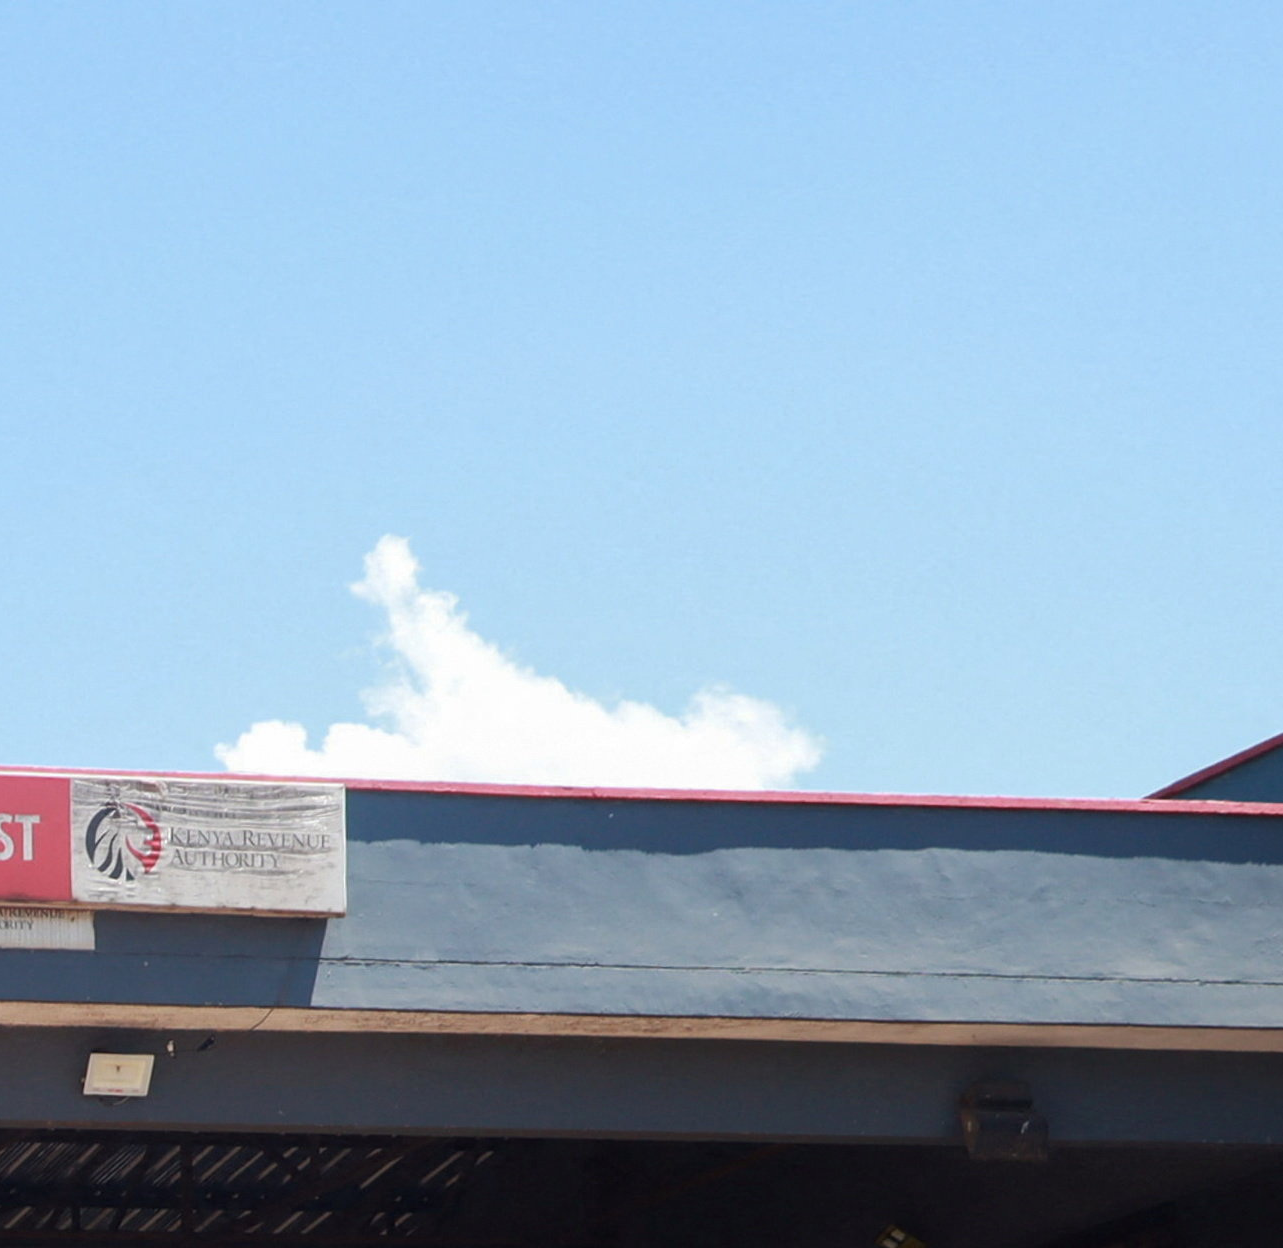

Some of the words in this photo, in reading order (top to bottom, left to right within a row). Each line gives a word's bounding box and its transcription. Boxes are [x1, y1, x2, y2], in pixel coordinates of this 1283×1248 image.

[169, 826, 235, 847] KENYA
[242, 829, 331, 849] REVENUE
[170, 849, 282, 869] AUTHORITY
[9, 908, 65, 919] REVENUE
